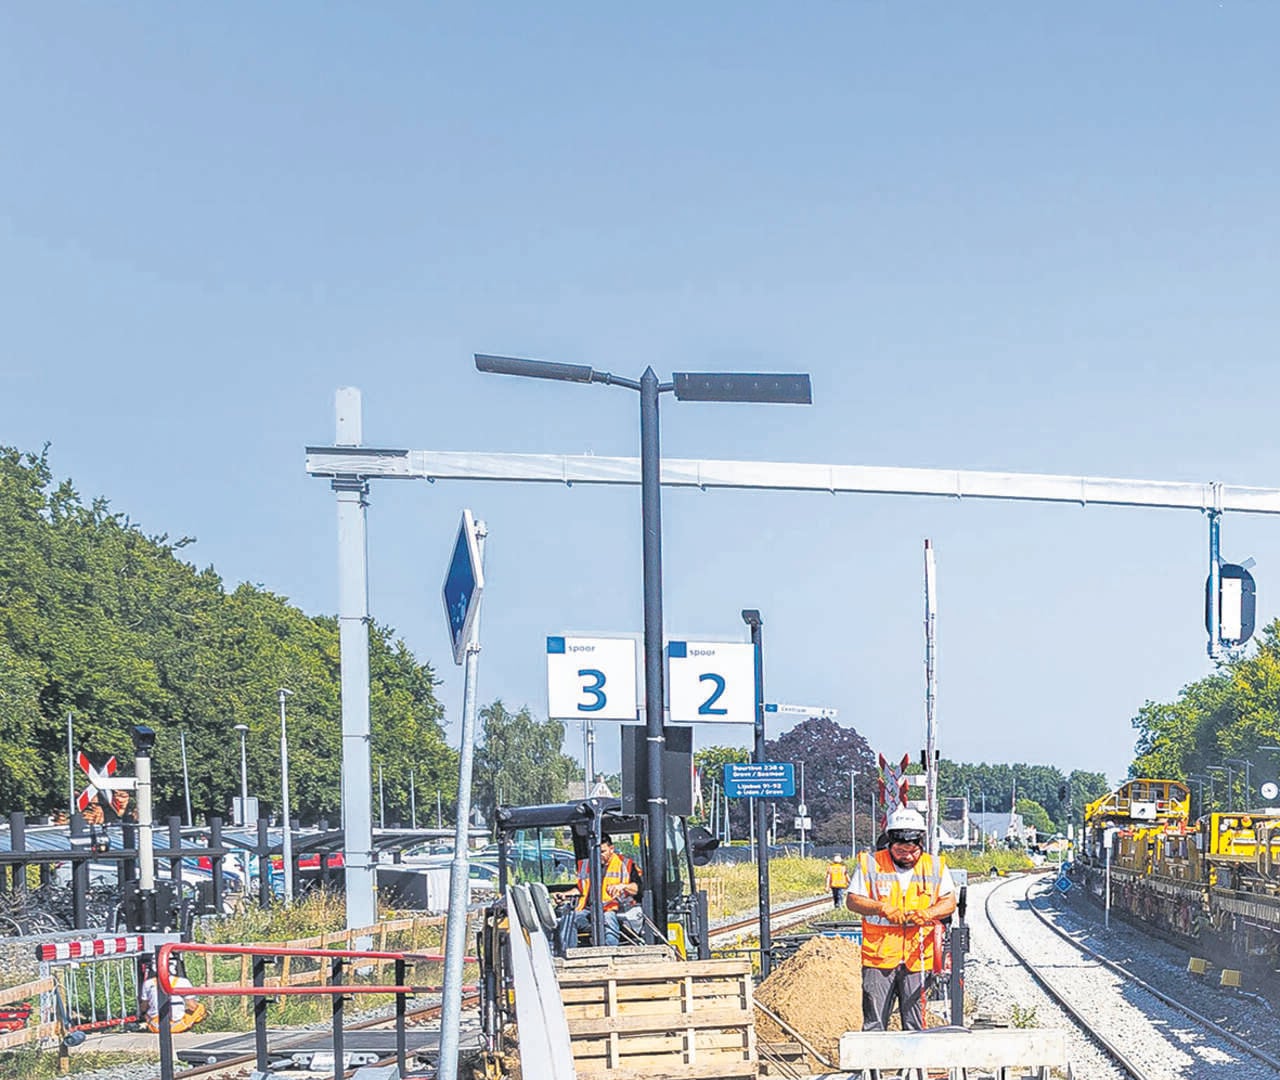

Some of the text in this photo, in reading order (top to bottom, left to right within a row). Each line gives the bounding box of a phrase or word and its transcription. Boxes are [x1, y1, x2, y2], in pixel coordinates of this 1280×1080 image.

[568, 644, 596, 653] spoor
[689, 648, 716, 657] spoor
[577, 668, 607, 712] 3
[697, 672, 728, 716] 2
